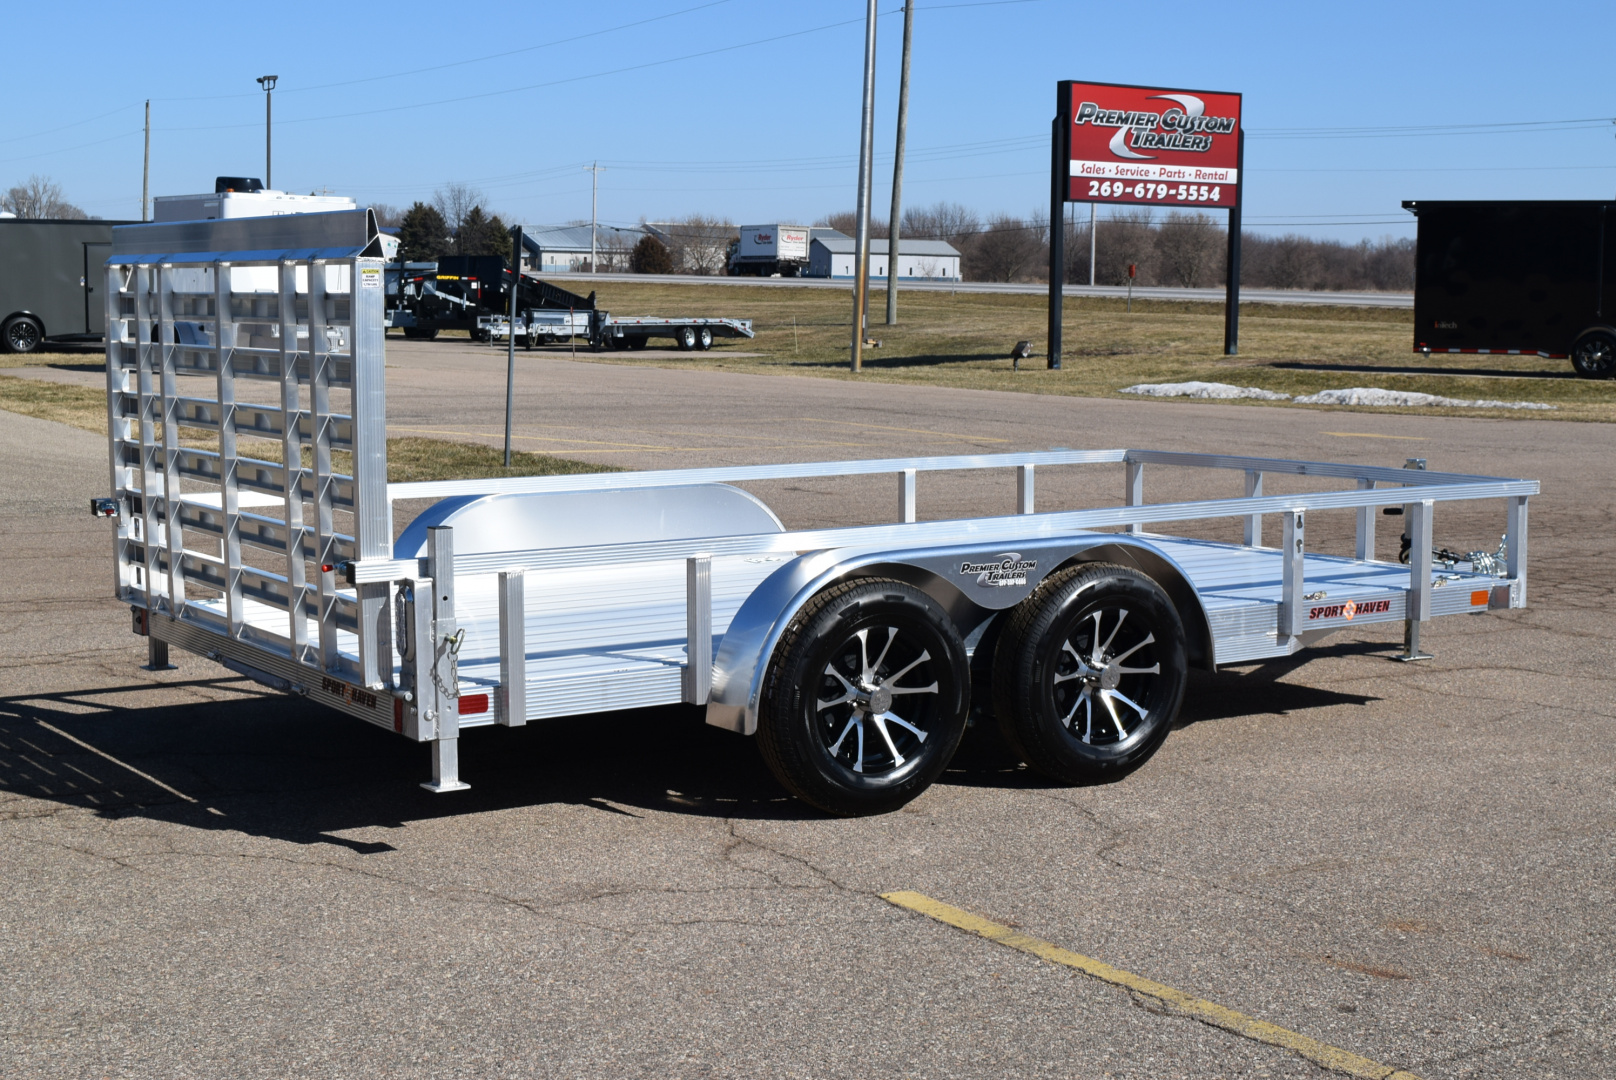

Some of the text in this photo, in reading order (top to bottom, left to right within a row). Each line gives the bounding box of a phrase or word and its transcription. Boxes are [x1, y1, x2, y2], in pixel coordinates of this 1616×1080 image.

[1075, 102, 1236, 134] PREMIER CUSTOM
[1130, 126, 1212, 152] TRAILERS
[1080, 163, 1228, 181] Sales Service Parts Rental
[1088, 181, 1220, 201] 269-679-5554
[960, 560, 1037, 574] PREMIER CUSTOM
[987, 571, 1026, 581] TRAILERS
[1309, 600, 1391, 619] SPORT HAVEN
[322, 677, 377, 710] SPORT HAVEN
